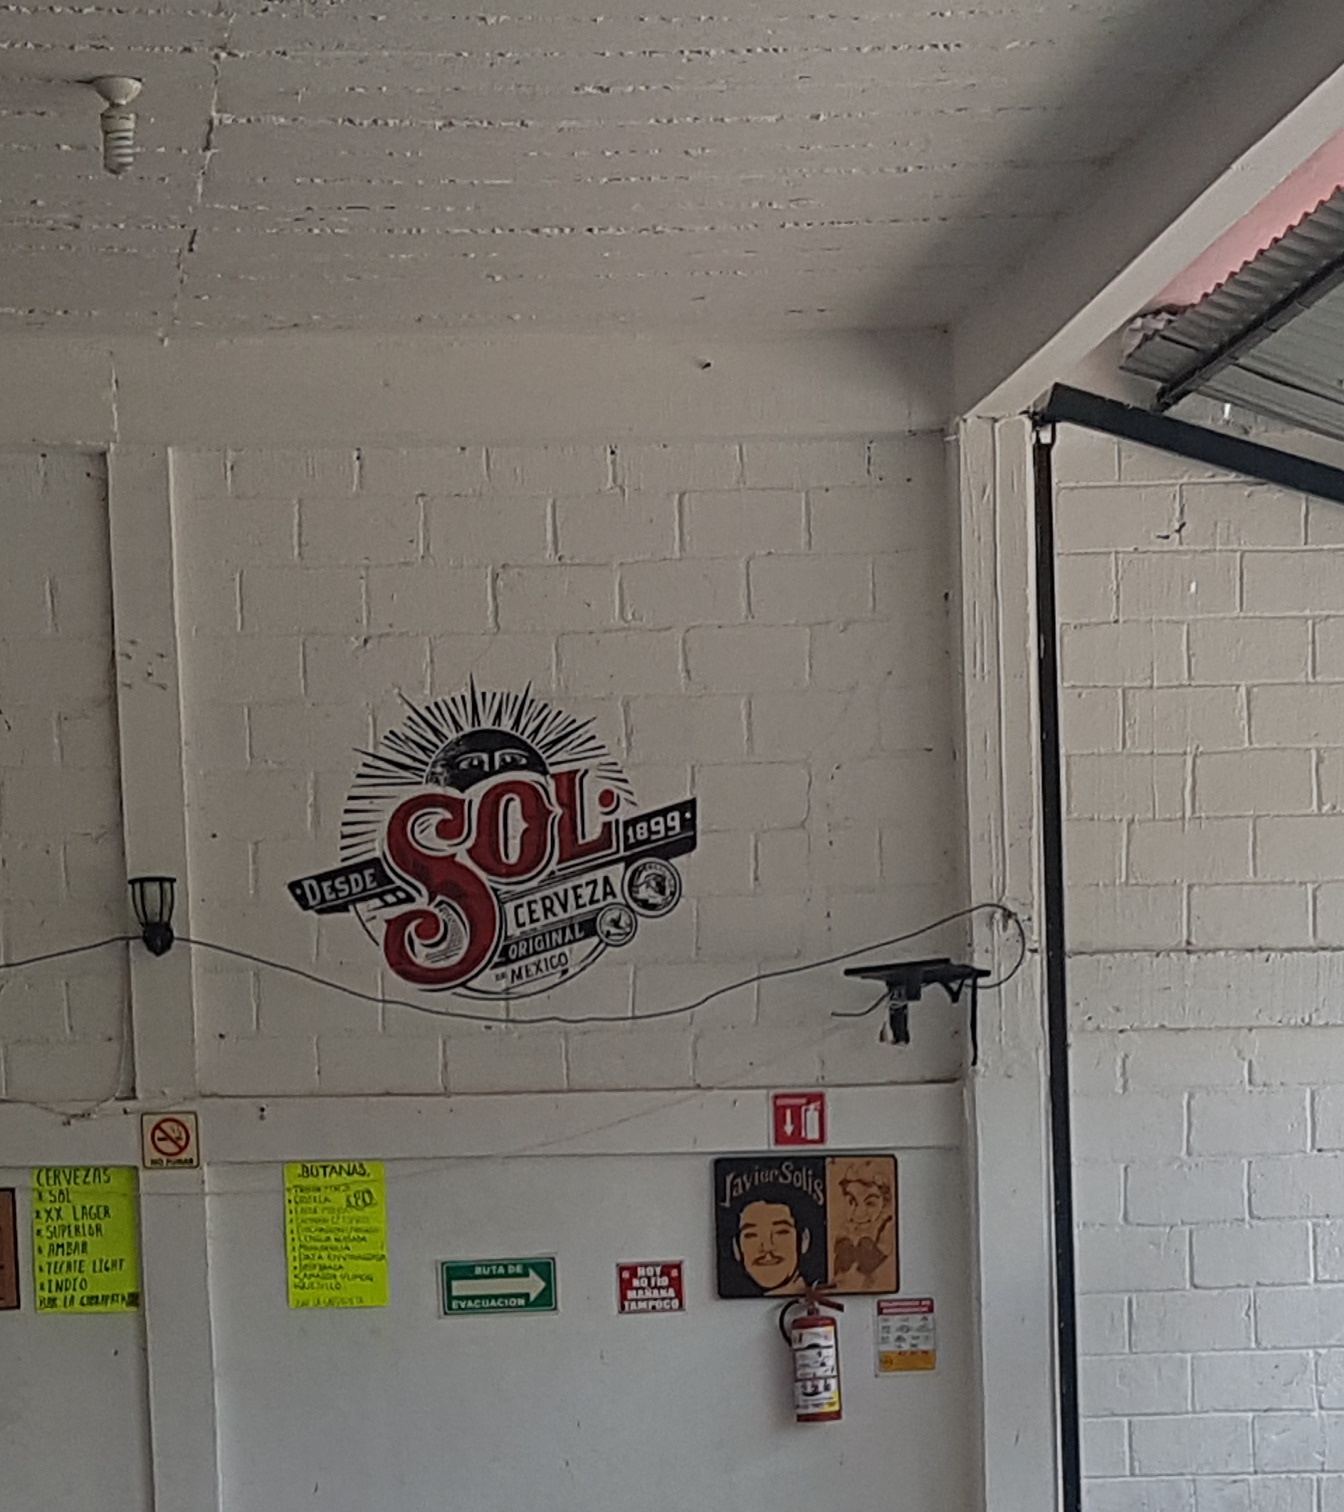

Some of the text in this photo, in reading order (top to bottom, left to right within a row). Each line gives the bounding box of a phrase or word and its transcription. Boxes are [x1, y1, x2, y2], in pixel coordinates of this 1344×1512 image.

[626, 811, 681, 844] 1899
[383, 768, 615, 985] SOL
[302, 868, 378, 907] DESDE
[513, 875, 617, 929] CERVEZA
[508, 922, 586, 960] ORIGINAL
[510, 952, 569, 984] MEXICO
[36, 1167, 111, 1187] CERVEZAS
[720, 1161, 825, 1208] Javier Solis
[49, 1189, 72, 1204] SOL
[45, 1205, 111, 1222] XX LAGER
[46, 1223, 104, 1240] SUPERIOR
[48, 1241, 88, 1257] AMBAR
[46, 1257, 126, 1275] TECATE LIGHT
[474, 1264, 523, 1275] RUTA DE
[637, 1264, 663, 1278] HOY
[47, 1276, 88, 1293] INDIO
[632, 1276, 669, 1288] NO FIO
[623, 1298, 680, 1312] TAMPOCO
